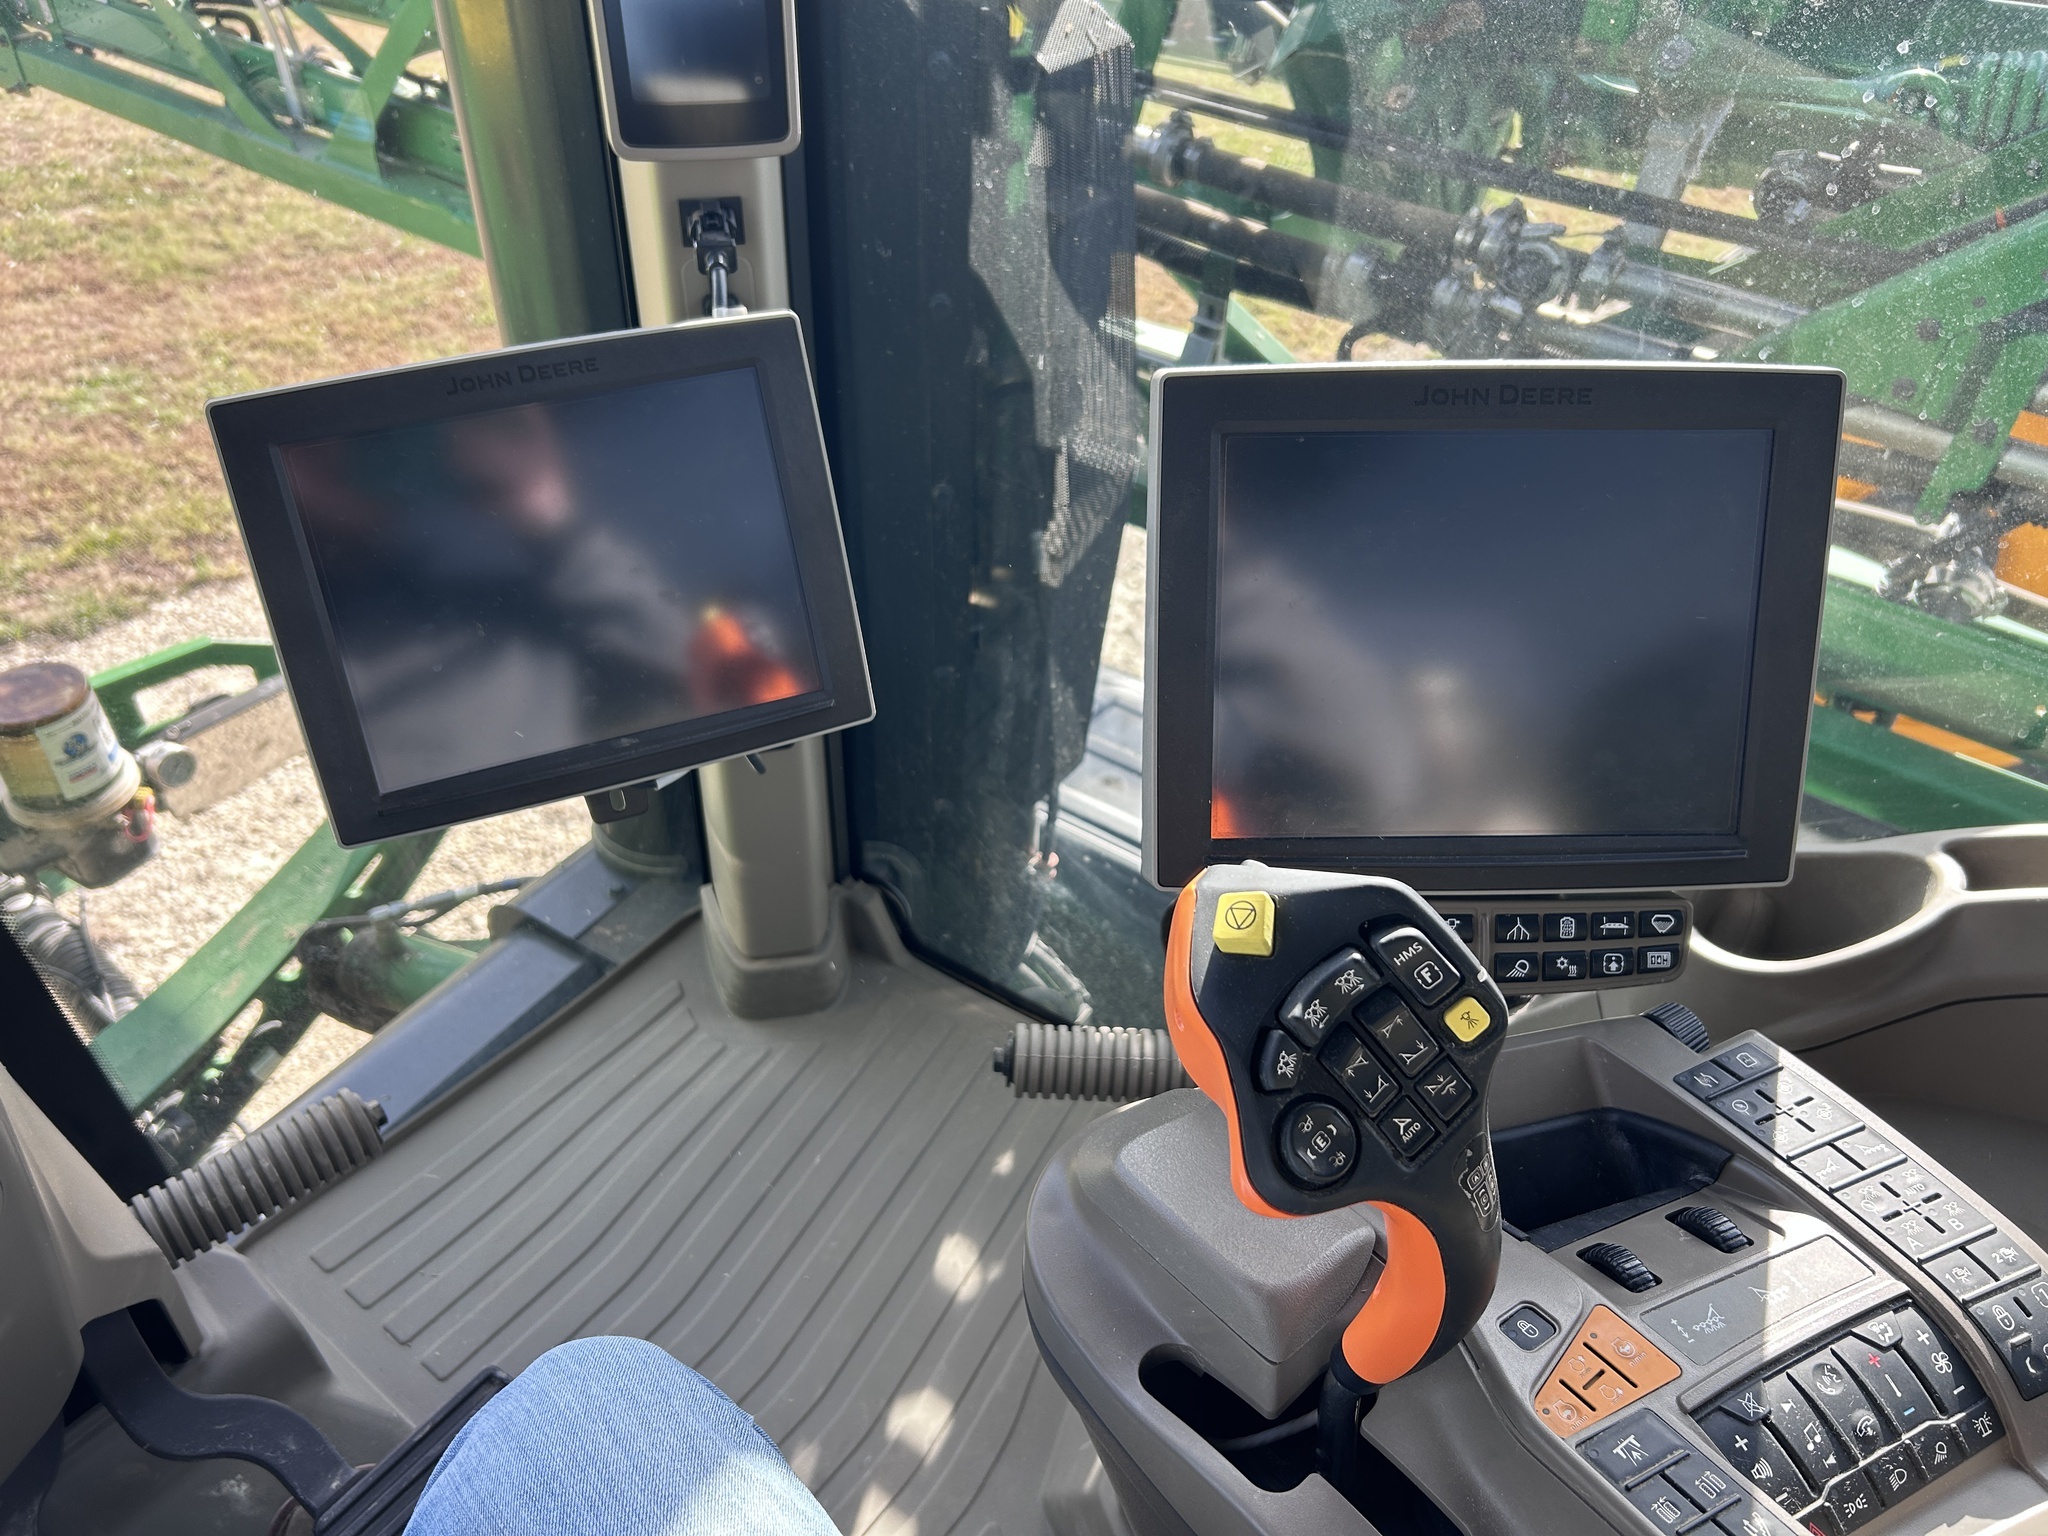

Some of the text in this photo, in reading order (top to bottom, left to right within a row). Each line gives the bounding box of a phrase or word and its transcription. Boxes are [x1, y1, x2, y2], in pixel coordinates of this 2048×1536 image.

[446, 357, 600, 396] JOHN DEERE
[1414, 384, 1593, 406] JOHN DEERE
[1393, 941, 1423, 966] HMS
[1420, 966, 1433, 984] F
[1401, 1122, 1421, 1143] AUTO
[1315, 1135, 1327, 1148] E
[1904, 1182, 1926, 1197] AUTO
[1947, 1218, 1965, 1232] B
[1906, 1236, 1925, 1251] A
[1991, 1252, 2004, 1264] 2
[1945, 1272, 1956, 1284] 1
